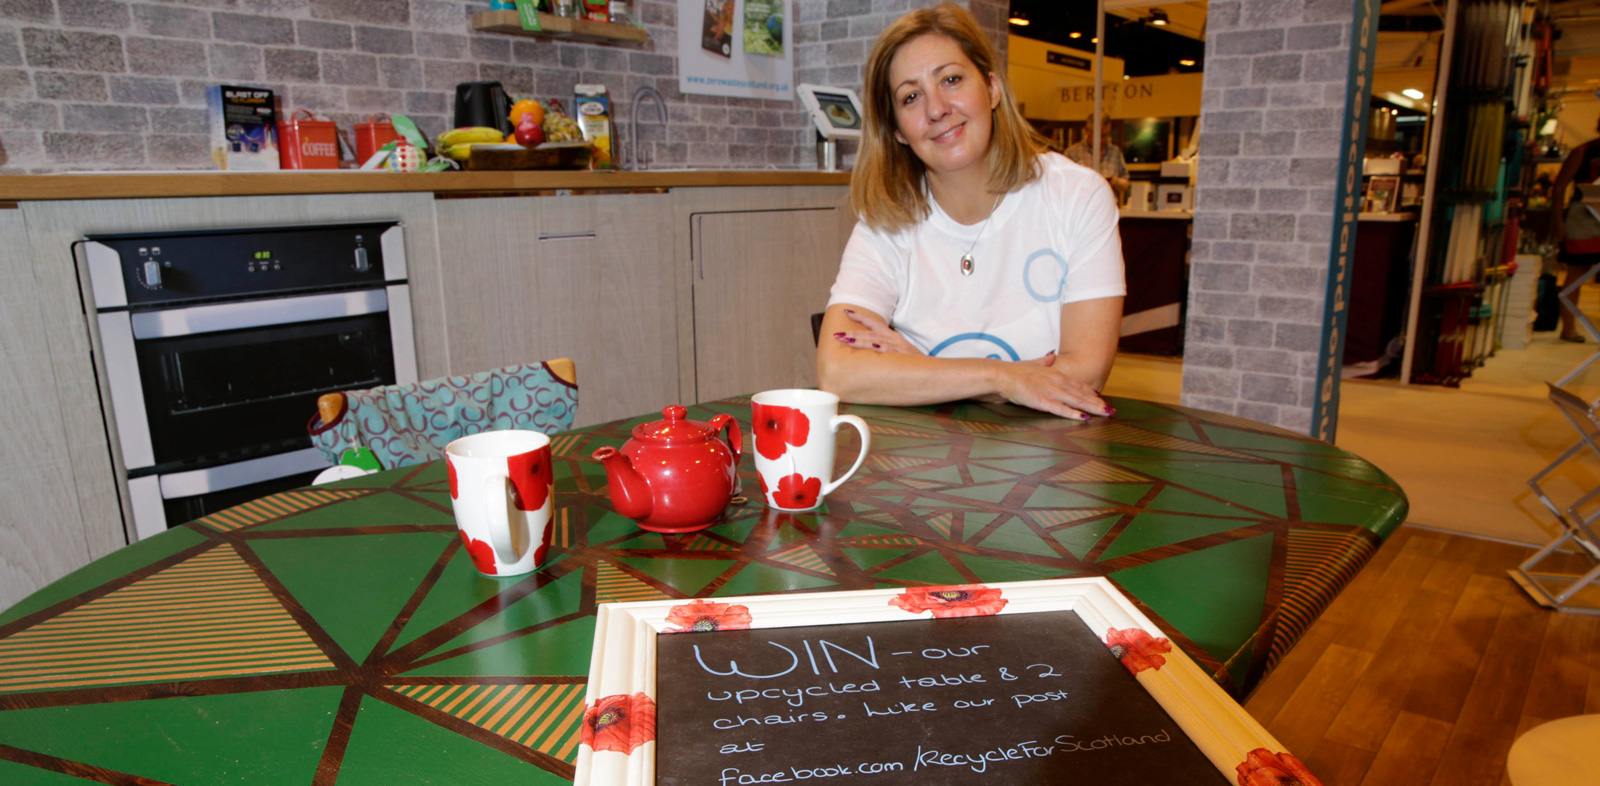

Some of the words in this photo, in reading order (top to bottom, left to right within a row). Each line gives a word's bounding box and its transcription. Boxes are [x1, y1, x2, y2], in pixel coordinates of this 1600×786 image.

[686, 76, 789, 92] www.zerowastescotland.org.uk
[253, 91, 269, 99] OFF
[302, 143, 336, 156] COFFEE
[693, 635, 880, 679] WIN
[922, 644, 990, 659] our
[707, 679, 881, 707] upcycled
[899, 673, 987, 689] table
[999, 666, 1019, 681] &
[1026, 663, 1062, 678] 2
[864, 701, 938, 717] Like
[953, 698, 995, 709] our
[1010, 689, 1068, 709] post
[719, 741, 765, 754] at
[718, 761, 904, 786] facebook.com
